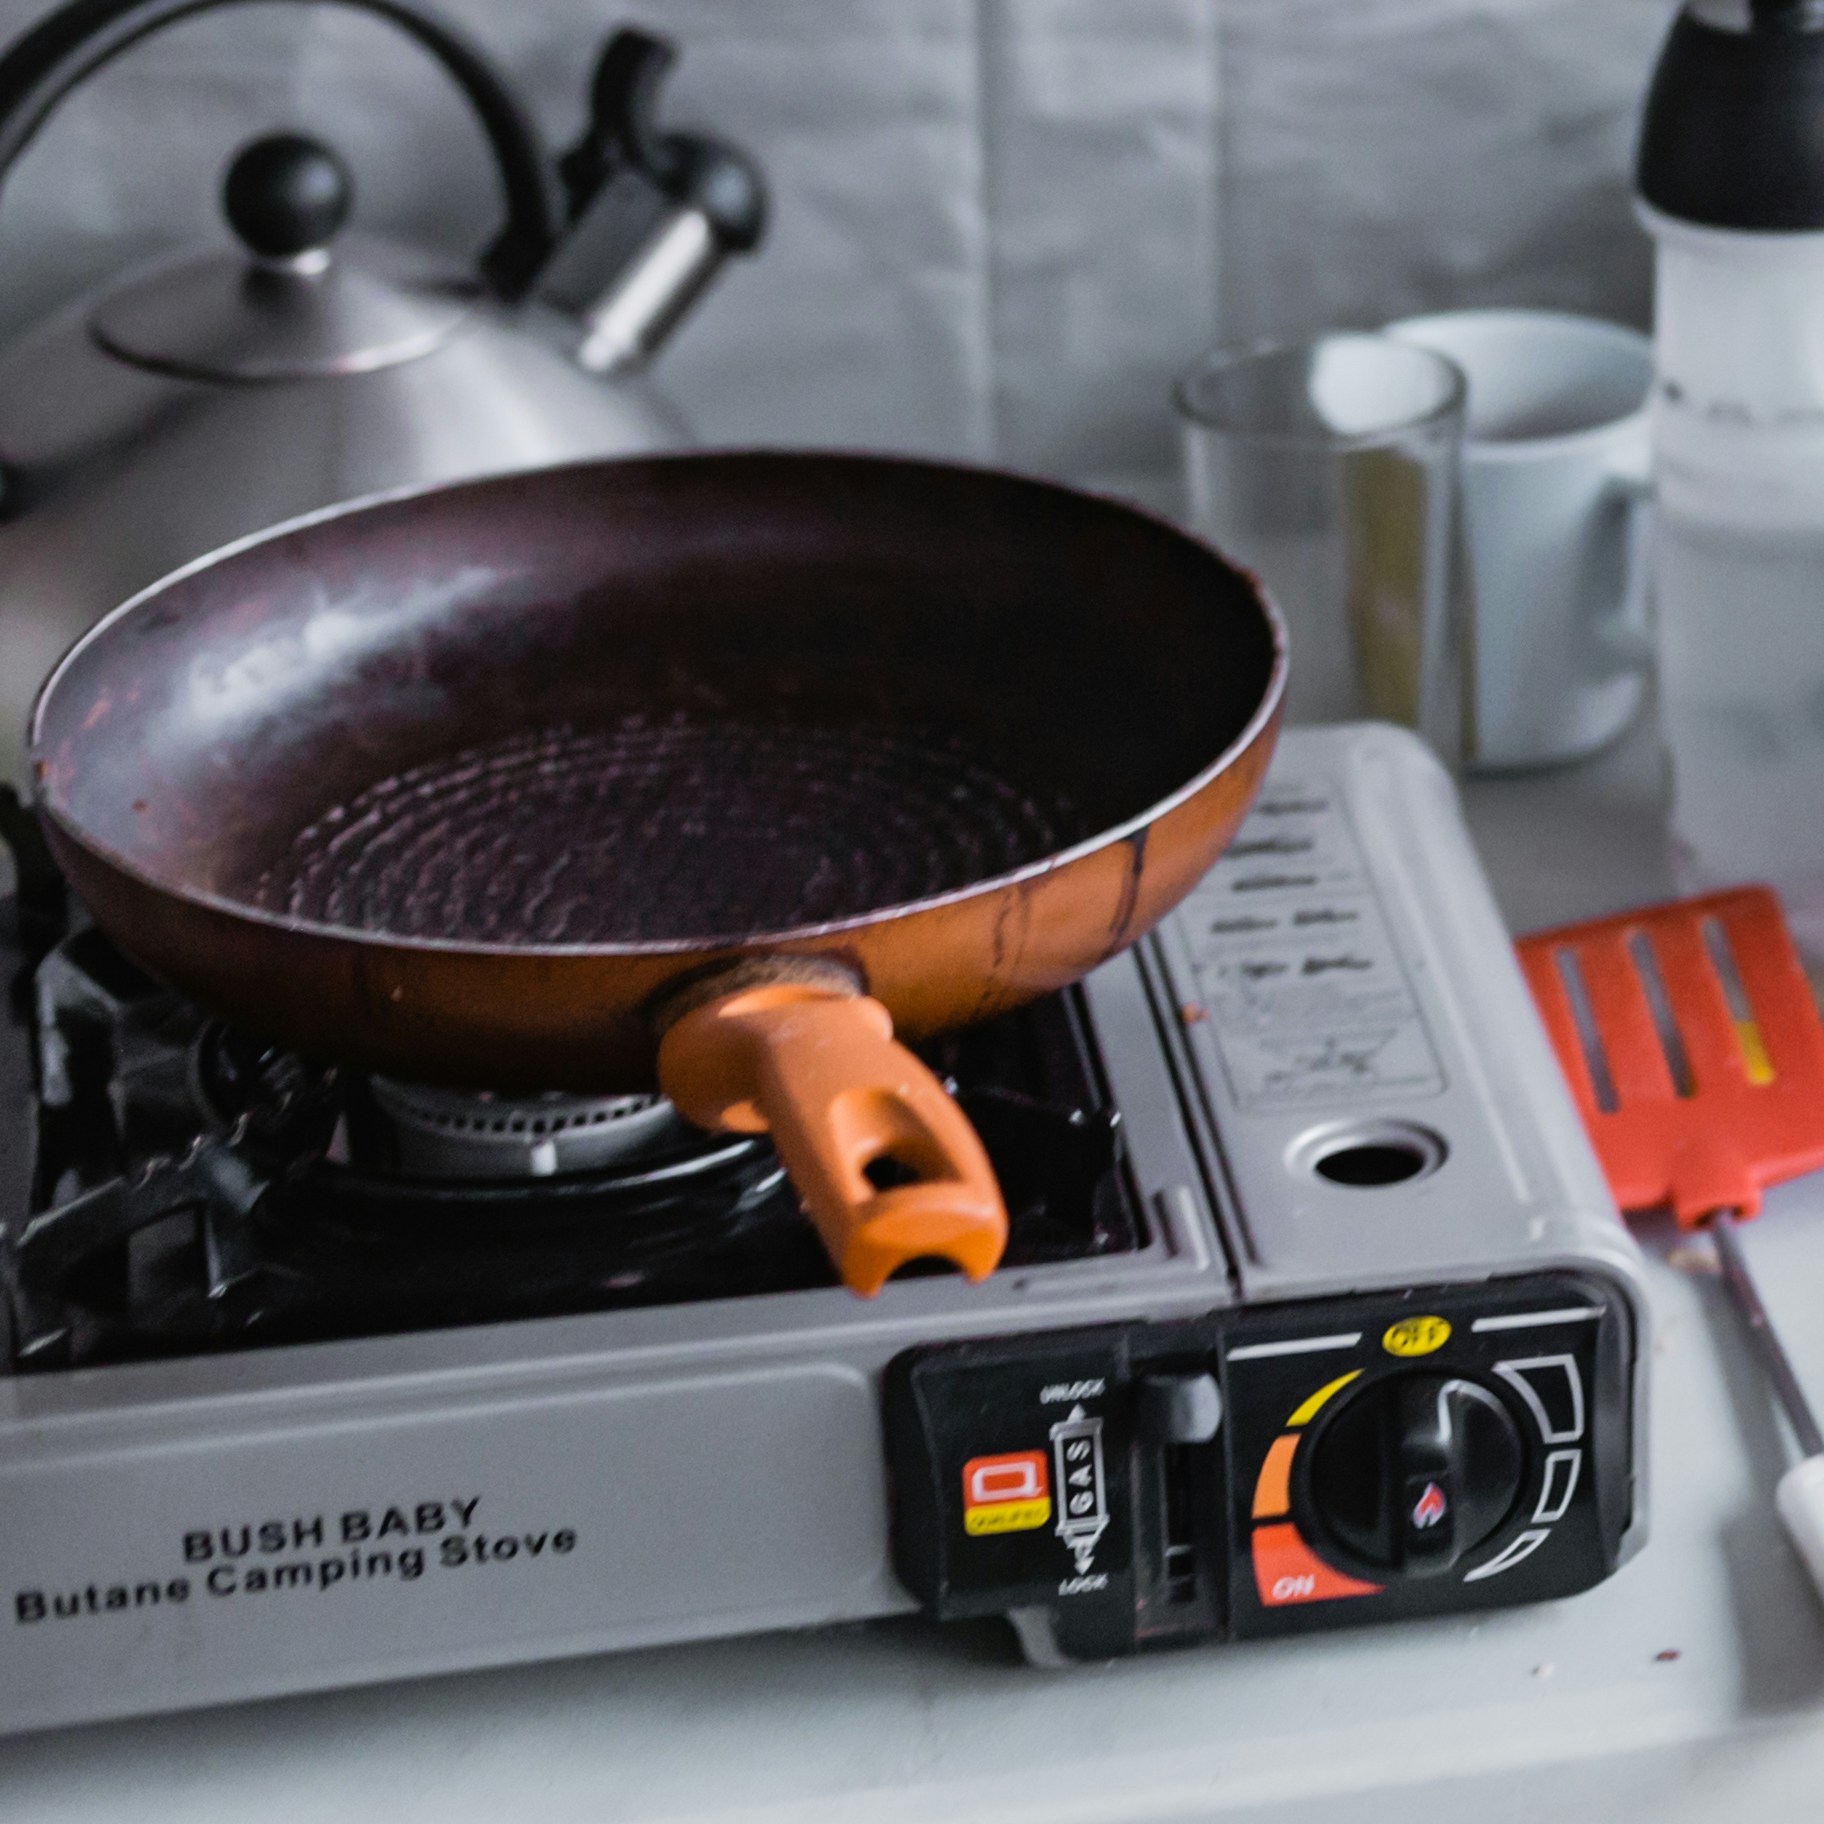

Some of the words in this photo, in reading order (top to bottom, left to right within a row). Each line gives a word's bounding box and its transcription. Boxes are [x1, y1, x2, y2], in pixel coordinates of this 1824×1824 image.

[1387, 1321, 1447, 1350] OFF
[1040, 1377, 1106, 1405] UNLOCK
[1066, 1439, 1095, 1515] GAS
[182, 1518, 324, 1565] BUSH
[341, 1497, 481, 1544] BABY
[15, 1578, 191, 1625] Butane
[207, 1545, 426, 1592] Camping
[440, 1528, 577, 1567] Stove
[1058, 1572, 1108, 1596] LOCK
[1271, 1573, 1315, 1601] ON
